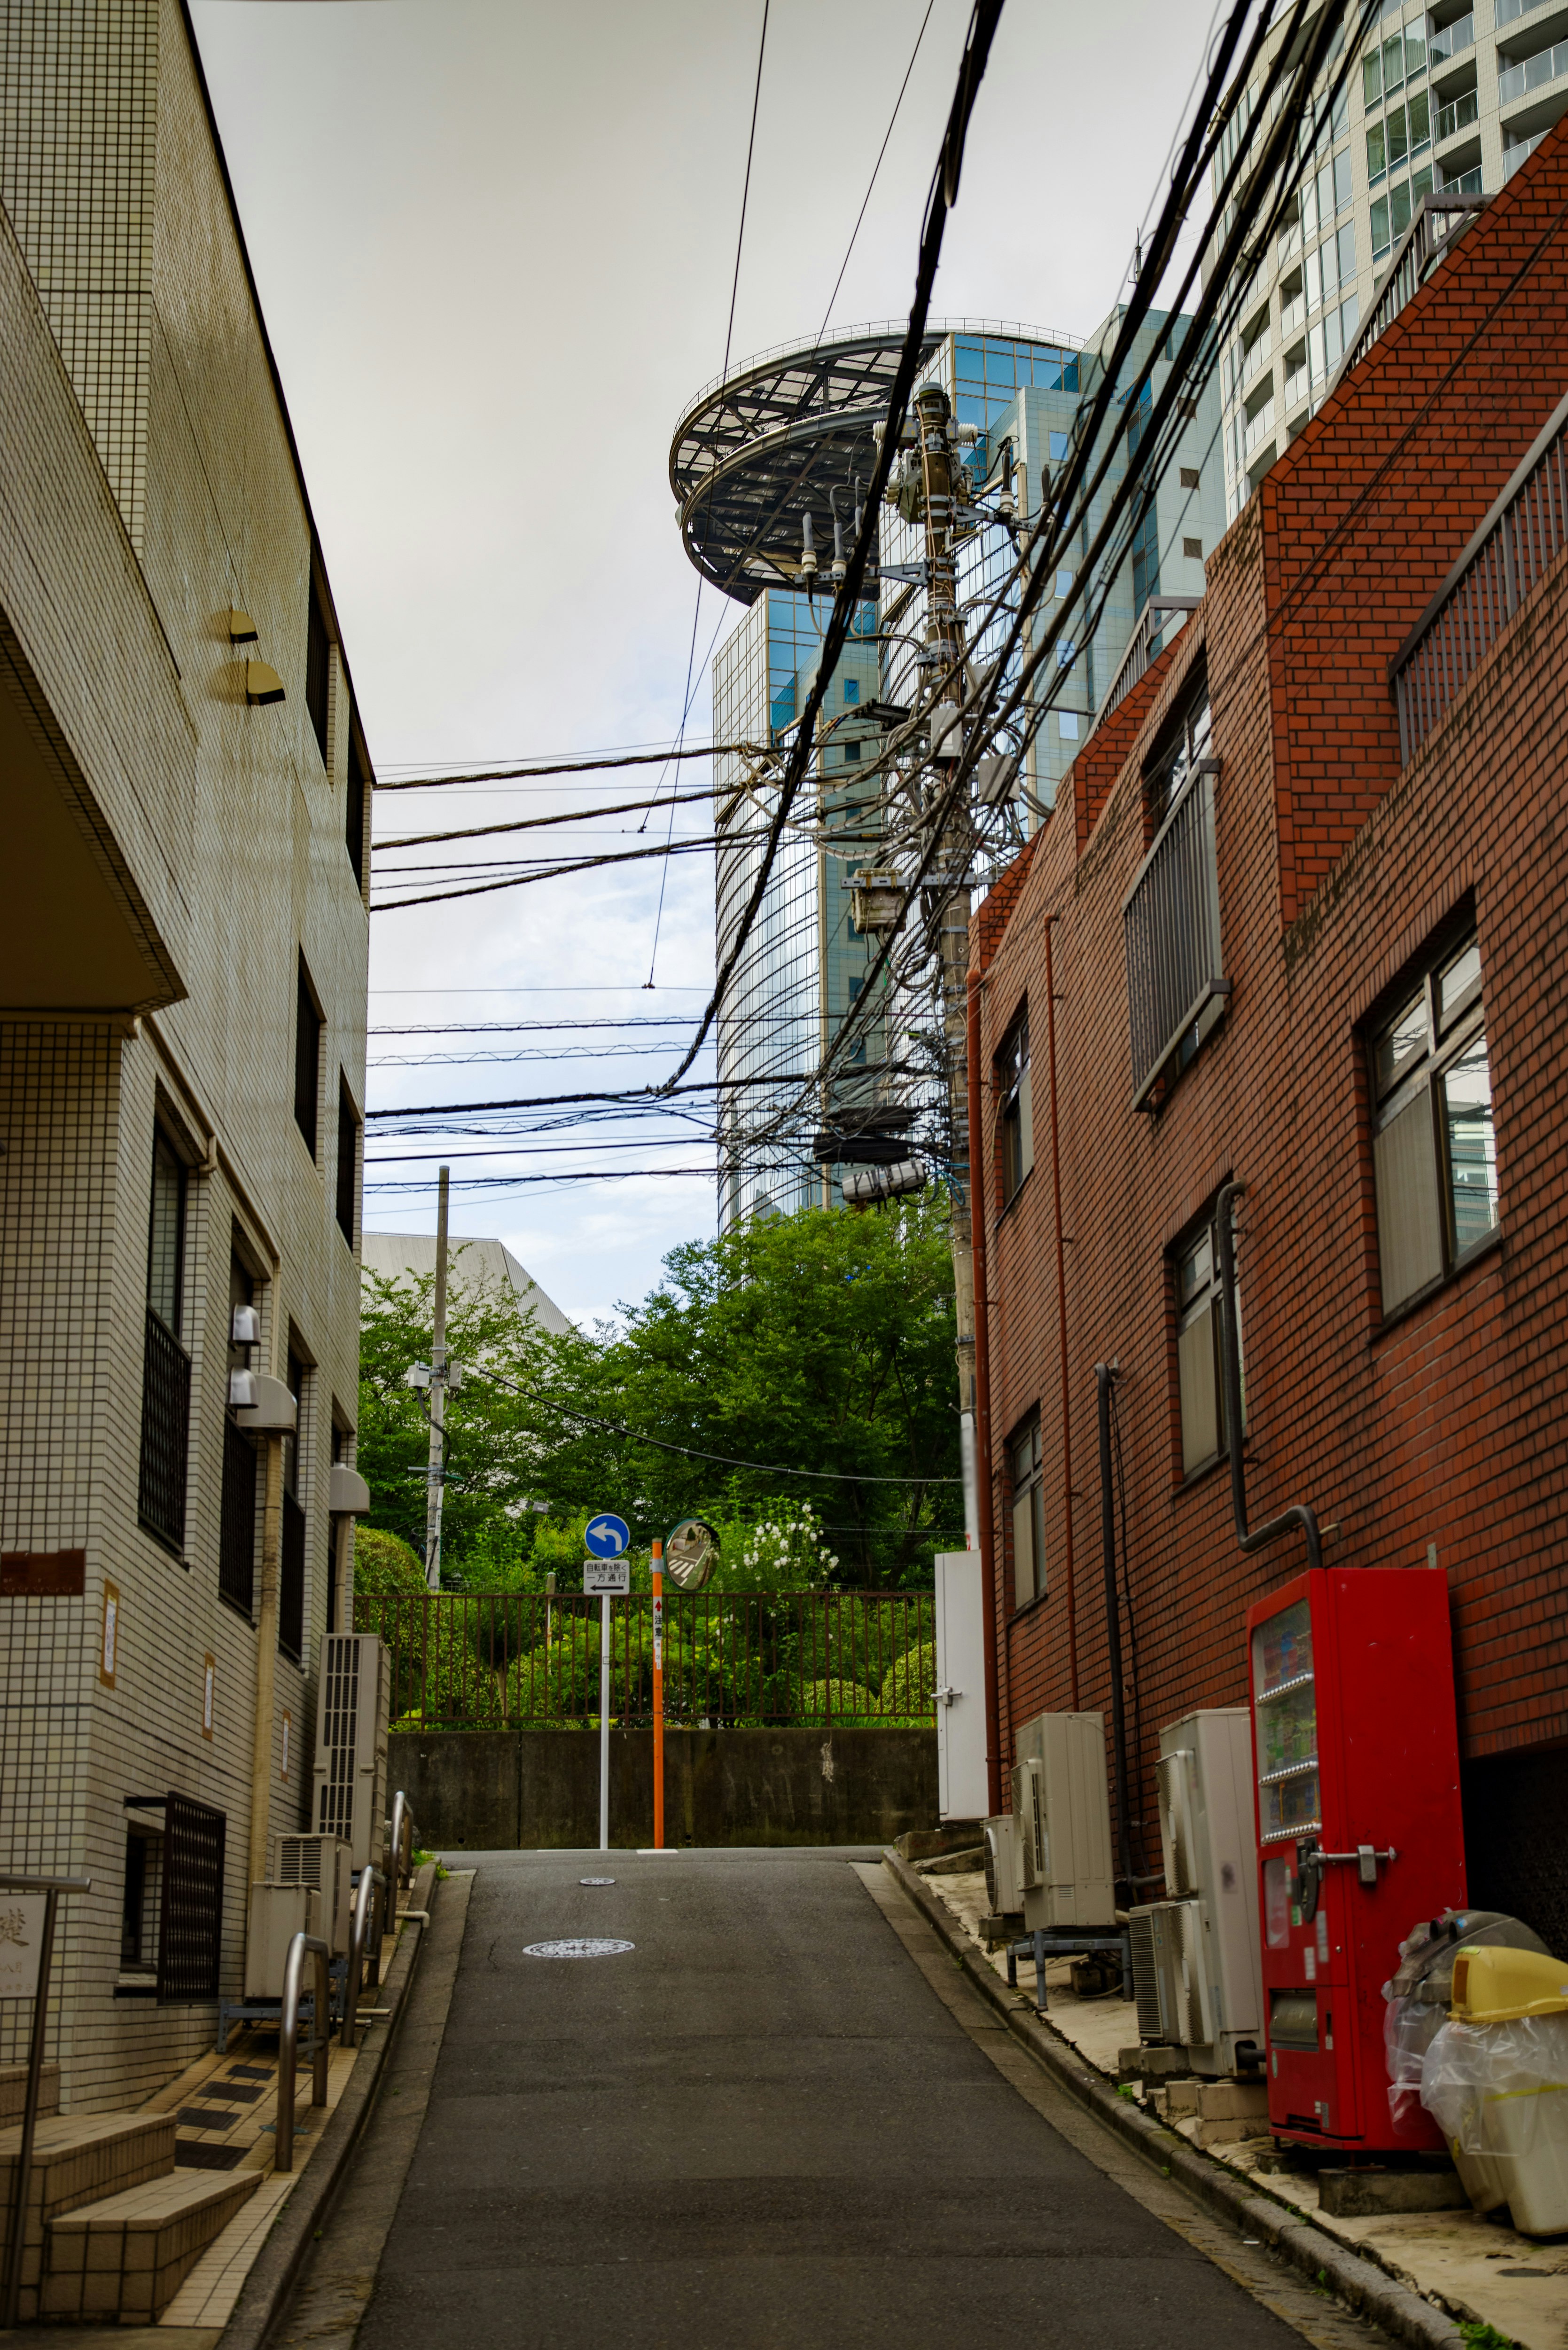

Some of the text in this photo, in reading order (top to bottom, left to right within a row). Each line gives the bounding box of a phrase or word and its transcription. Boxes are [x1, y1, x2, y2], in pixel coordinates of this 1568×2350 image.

[587, 1563, 626, 1572] 自転車を除く
[587, 1574, 626, 1582] 一方通行
[655, 1615, 663, 1637] 注意
